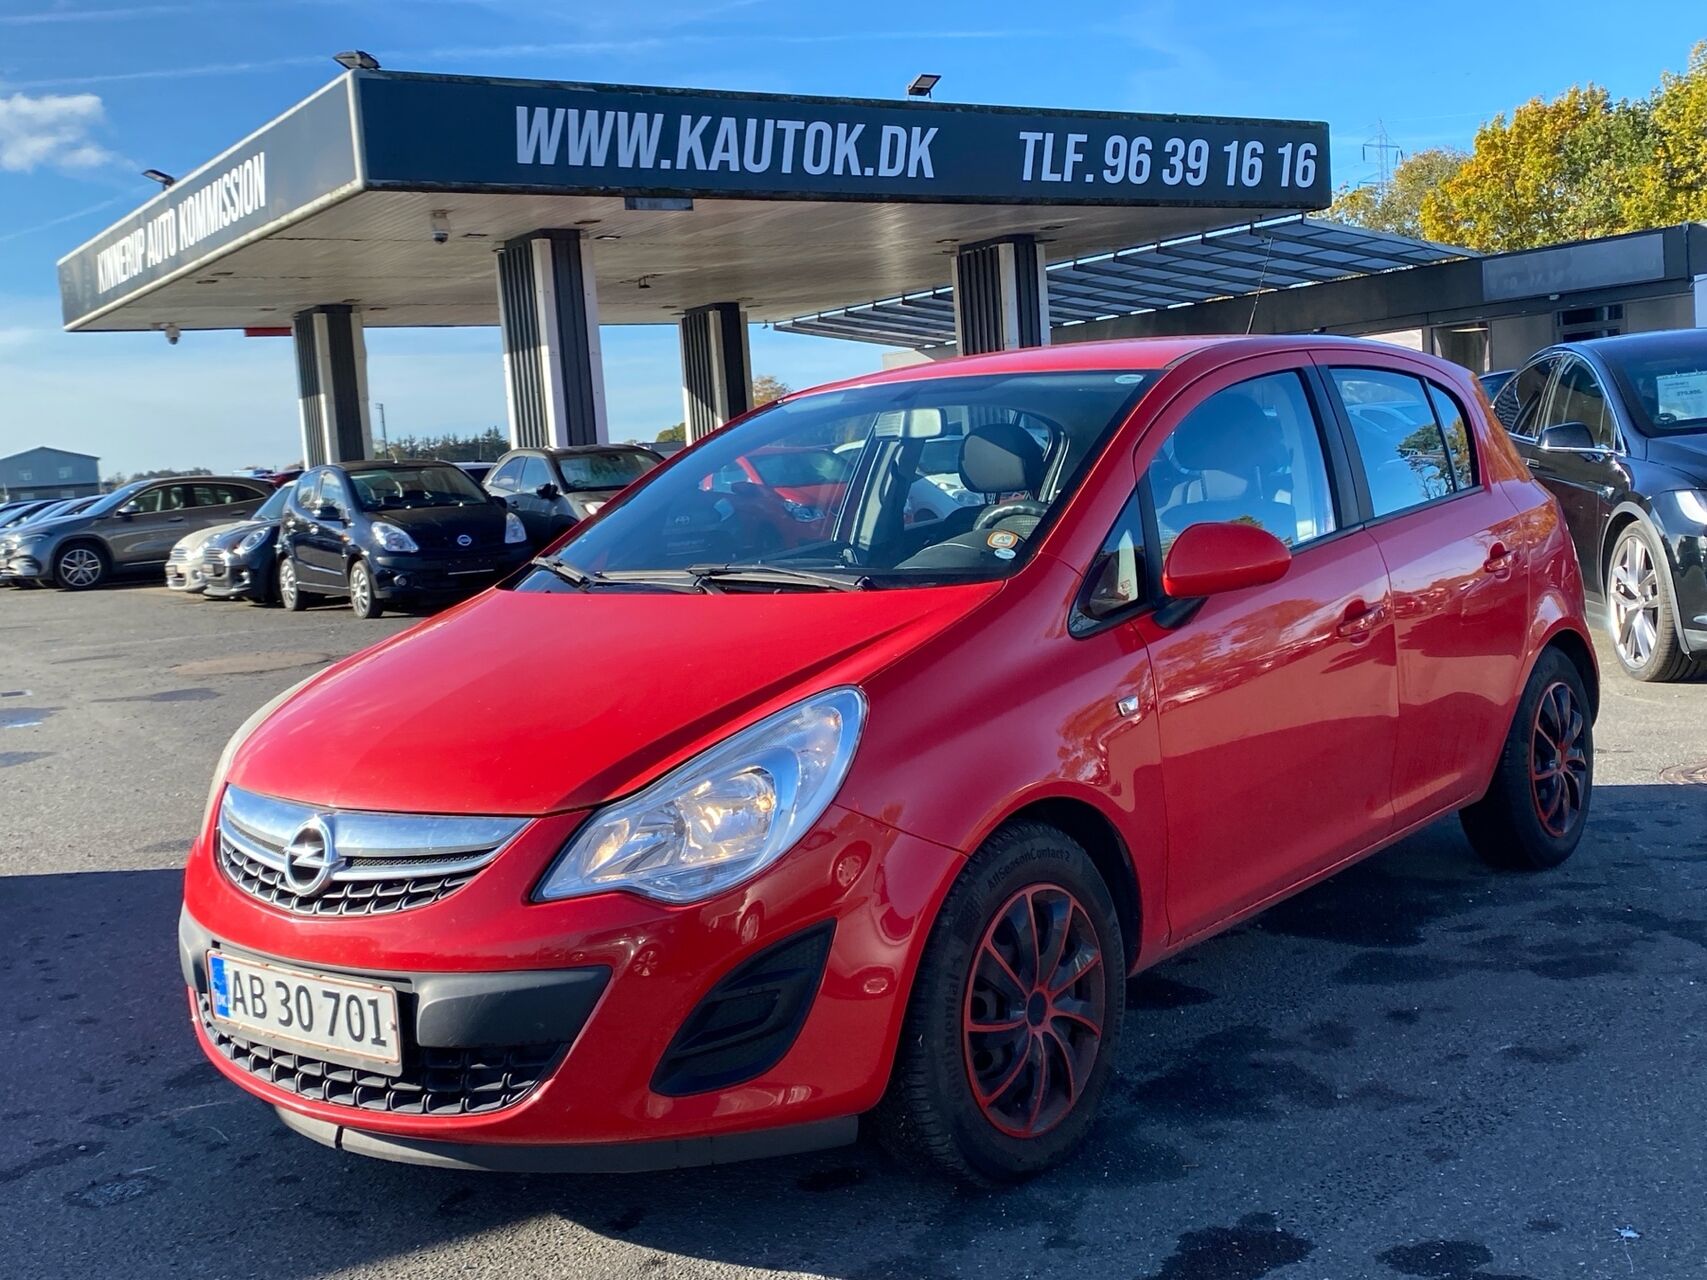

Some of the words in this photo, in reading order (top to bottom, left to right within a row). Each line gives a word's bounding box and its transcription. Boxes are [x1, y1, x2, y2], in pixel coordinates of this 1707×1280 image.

[515, 105, 939, 178] WWW.KAUTOK.DK
[1019, 131, 1094, 183] TLF.
[1102, 134, 1153, 185] 96
[1162, 137, 1210, 187] 39
[1223, 140, 1265, 187] 16
[1277, 142, 1318, 188] 16
[147, 207, 177, 268] AUTO
[178, 151, 266, 251] KOMMISSION
[232, 970, 268, 1020] AB
[275, 980, 314, 1033] 30
[322, 990, 387, 1047] 701
